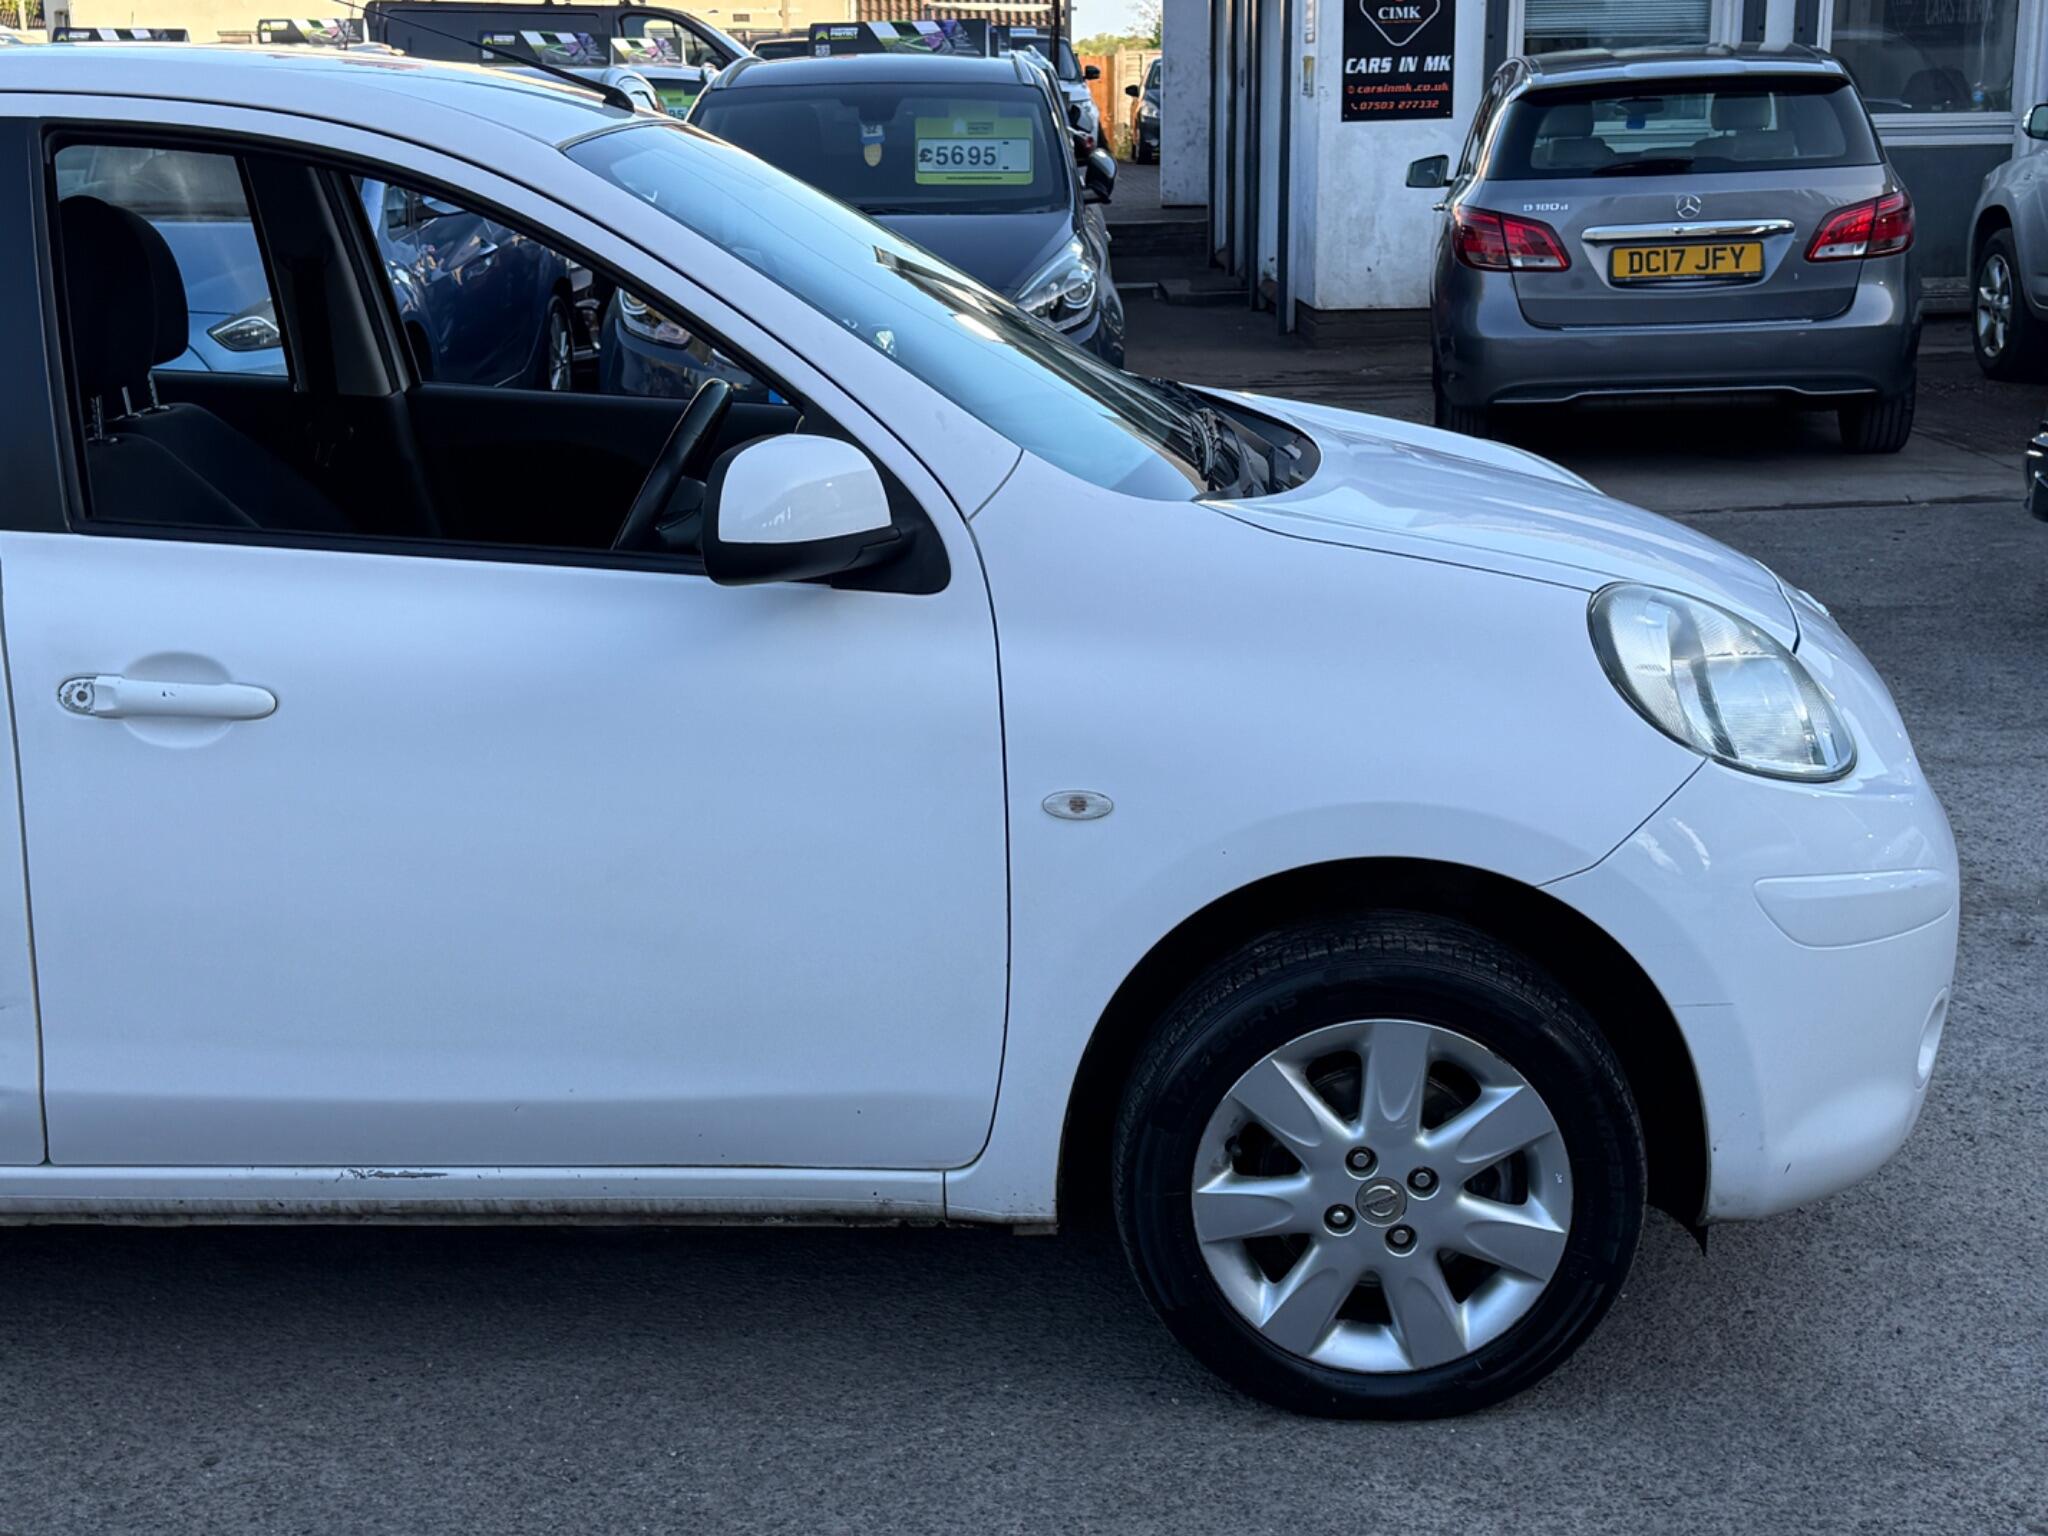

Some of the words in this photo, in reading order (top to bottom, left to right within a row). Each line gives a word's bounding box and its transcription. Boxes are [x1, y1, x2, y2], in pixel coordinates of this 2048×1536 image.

[1377, 6, 1421, 19] CIMK
[1345, 57, 1392, 74] CARS
[1398, 56, 1418, 73] IN
[1424, 55, 1451, 72] MK
[919, 145, 997, 165] £5695
[1628, 249, 1686, 274] DC17
[1695, 246, 1745, 271] JFY
